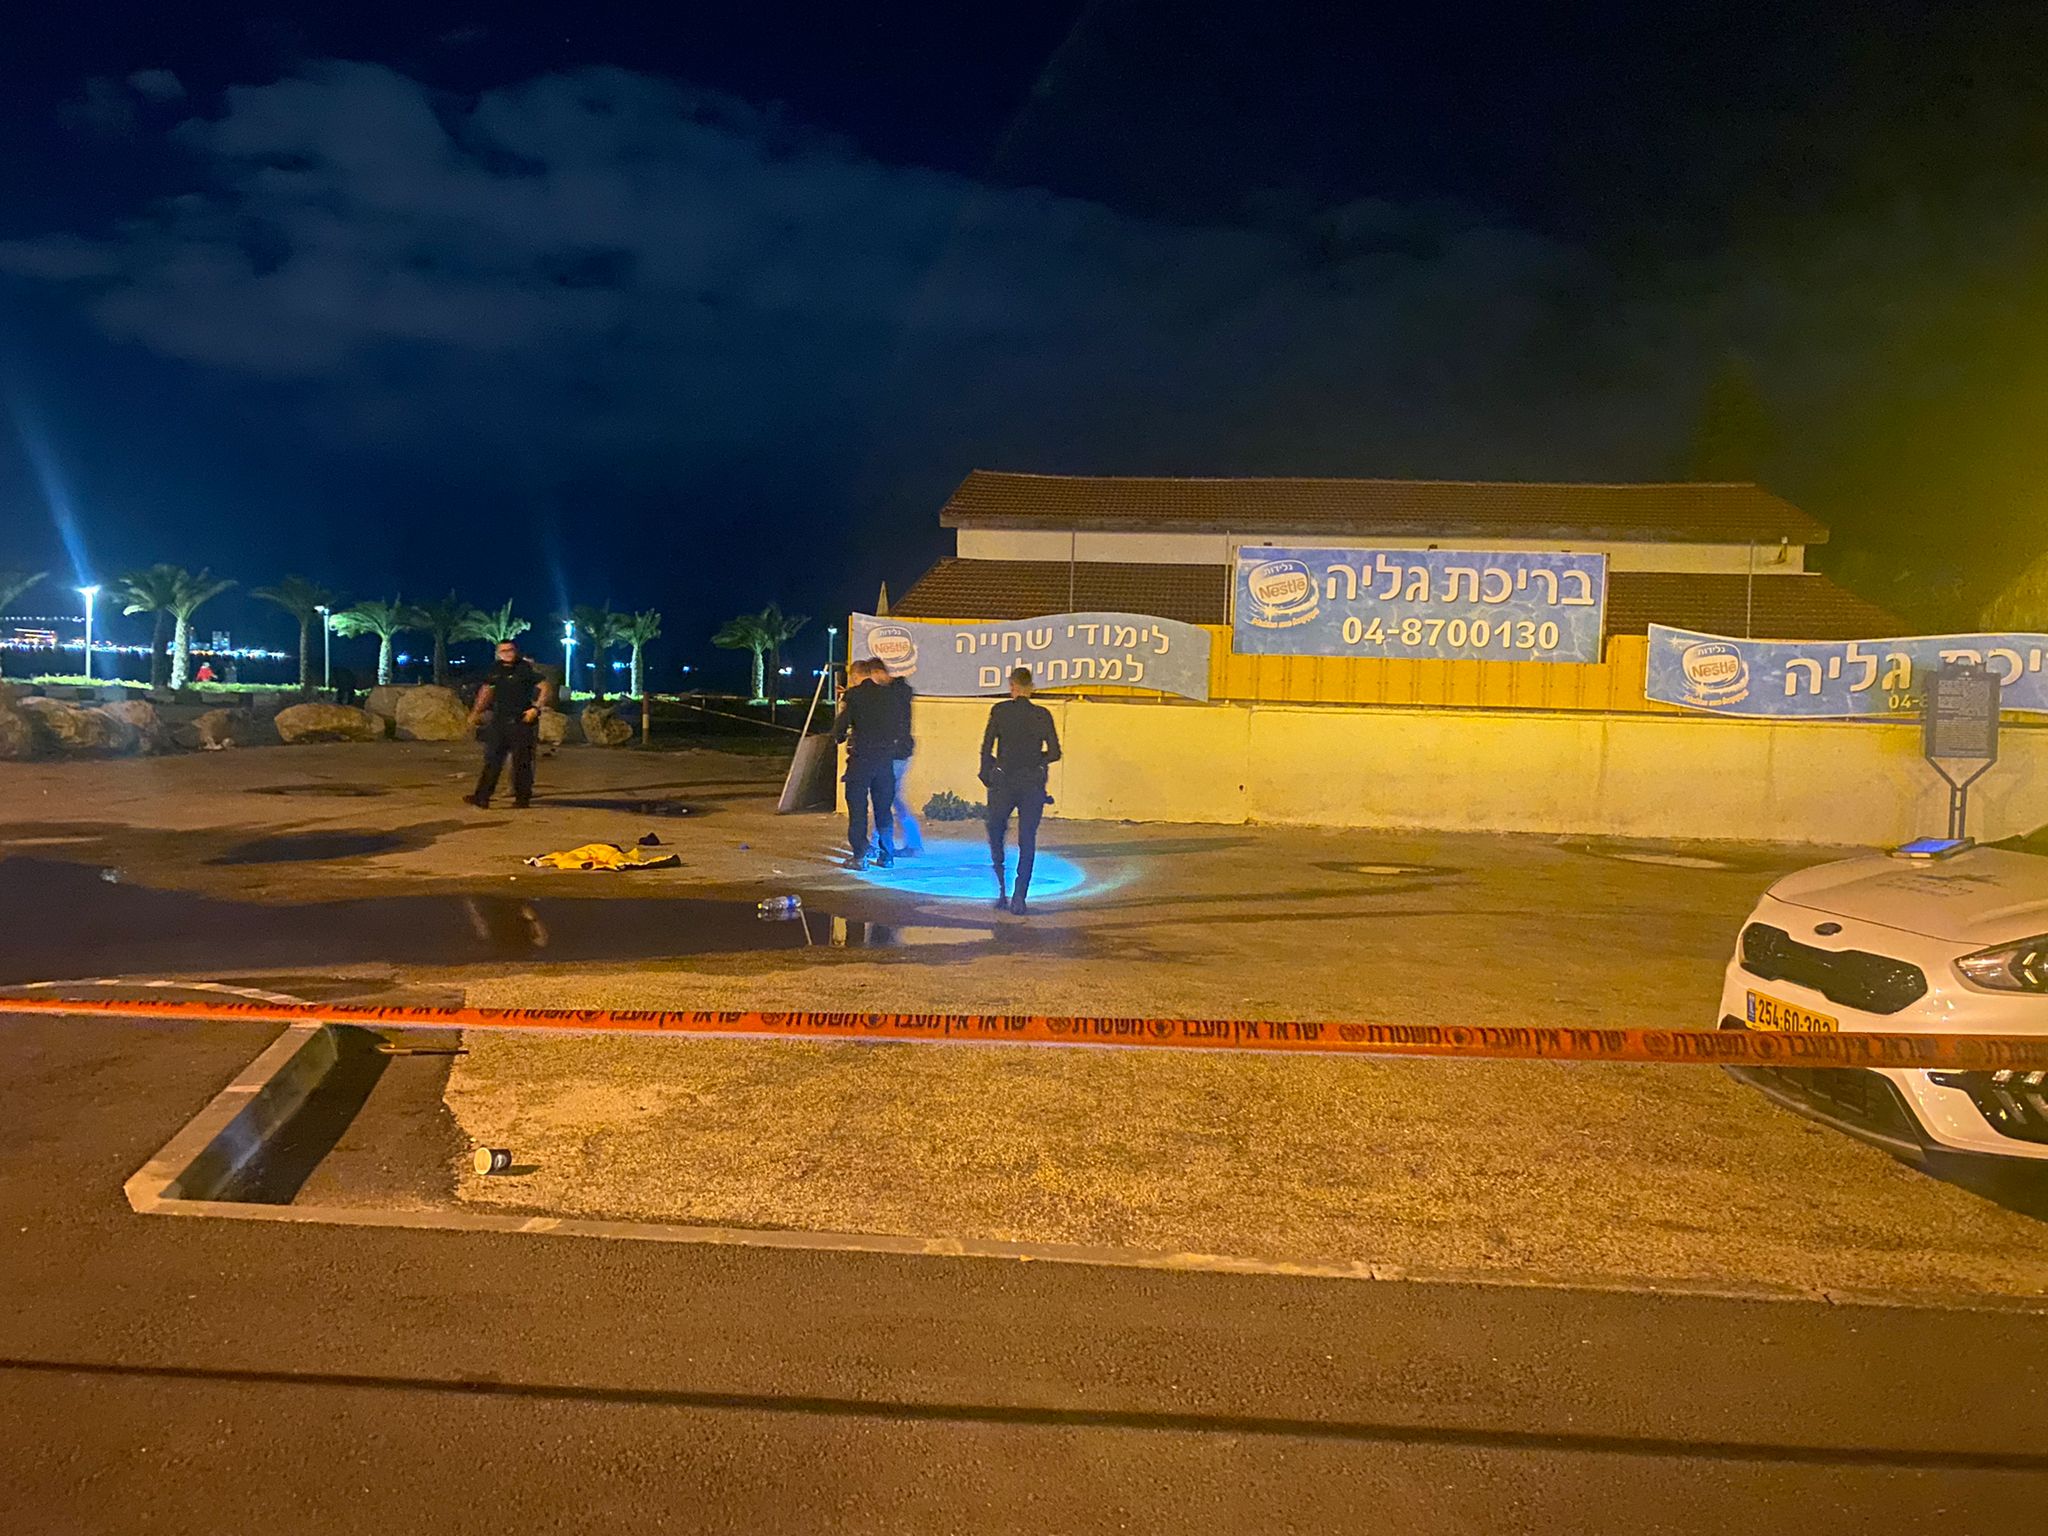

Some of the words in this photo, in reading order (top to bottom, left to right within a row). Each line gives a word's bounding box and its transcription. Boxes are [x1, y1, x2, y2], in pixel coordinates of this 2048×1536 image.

[1259, 577, 1306, 599] Nestlé
[1326, 553, 1430, 602] גליה
[1442, 565, 1596, 606] בריכת
[955, 627, 1054, 655] שחייה
[1067, 623, 1171, 655] לימודי
[1341, 617, 1560, 650] 04-8700130
[1691, 660, 1737, 678] Nestlé
[1784, 643, 1912, 696] גליה
